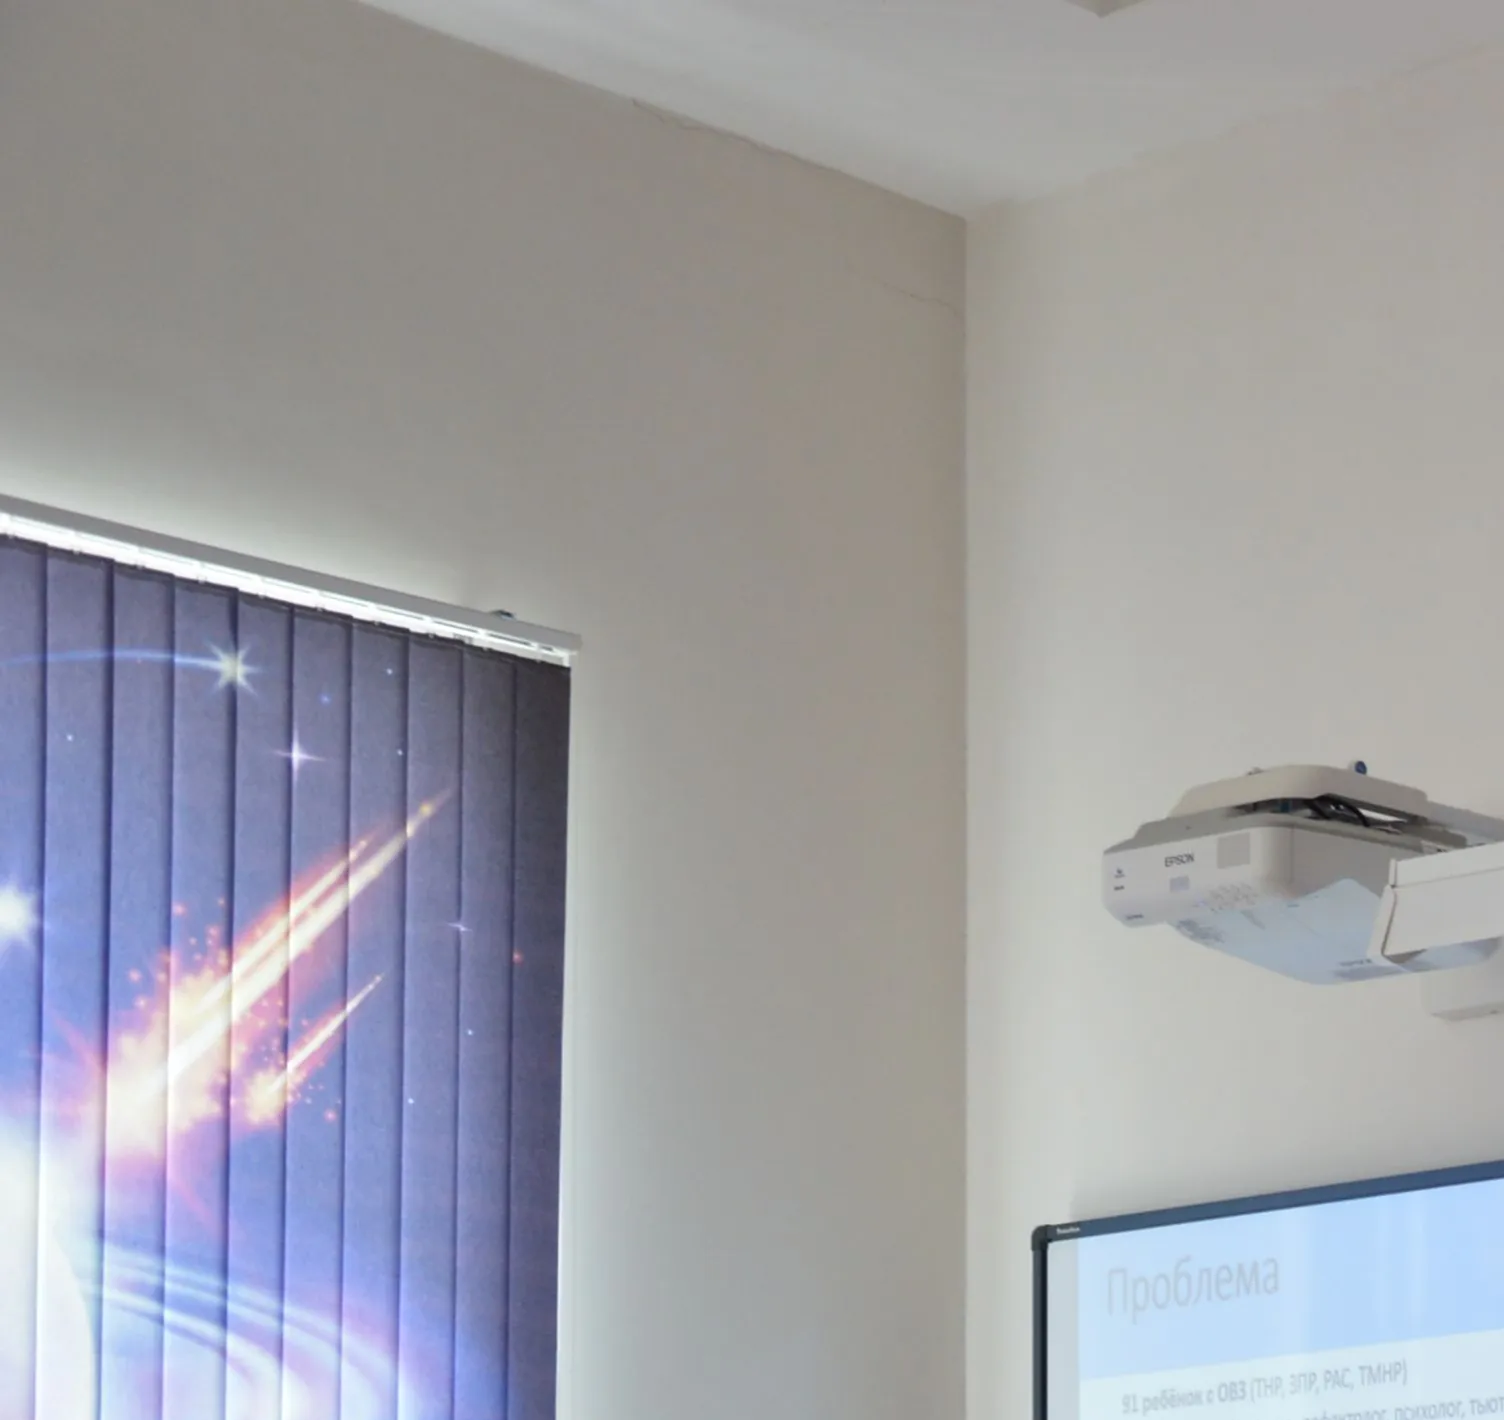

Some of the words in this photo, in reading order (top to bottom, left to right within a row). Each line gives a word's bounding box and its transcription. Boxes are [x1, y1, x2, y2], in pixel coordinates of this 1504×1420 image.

[1164, 853, 1195, 868] EPSON
[1107, 1254, 1280, 1326] Проблема
[1121, 1393, 1139, 1414] 91
